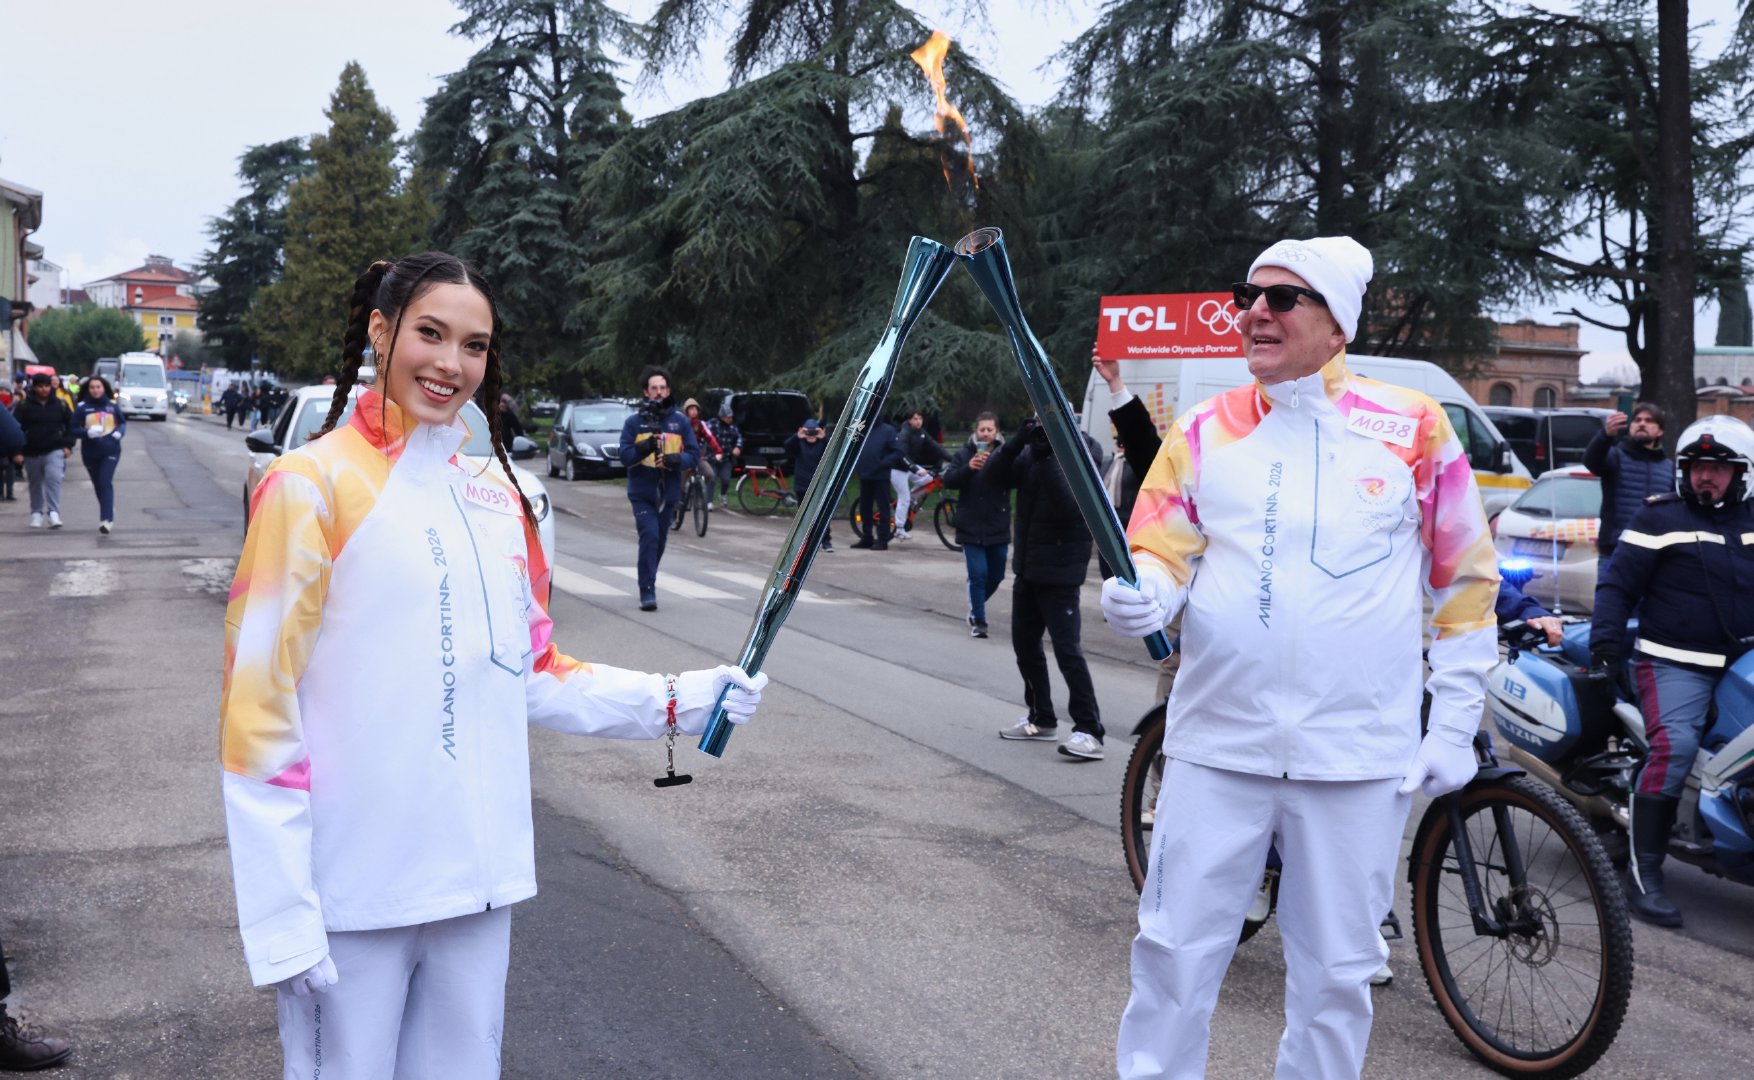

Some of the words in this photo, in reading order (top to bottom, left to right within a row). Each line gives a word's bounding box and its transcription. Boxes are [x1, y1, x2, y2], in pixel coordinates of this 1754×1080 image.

[1102, 305, 1177, 332] TCL
[1127, 345, 1170, 354] Worldwide
[1171, 345, 1204, 355] Olympic
[1205, 344, 1238, 353] Partner
[1351, 415, 1411, 438] M038
[1268, 461, 1283, 488] 2026
[466, 482, 510, 508] M039
[1262, 491, 1279, 557] CORTINA
[424, 527, 447, 567] 2026
[1258, 559, 1273, 630] MILANO
[439, 573, 455, 667] CORTINA
[1504, 676, 1527, 700] 113
[442, 671, 457, 761] MILANO
[1495, 714, 1543, 746] LIZIA
